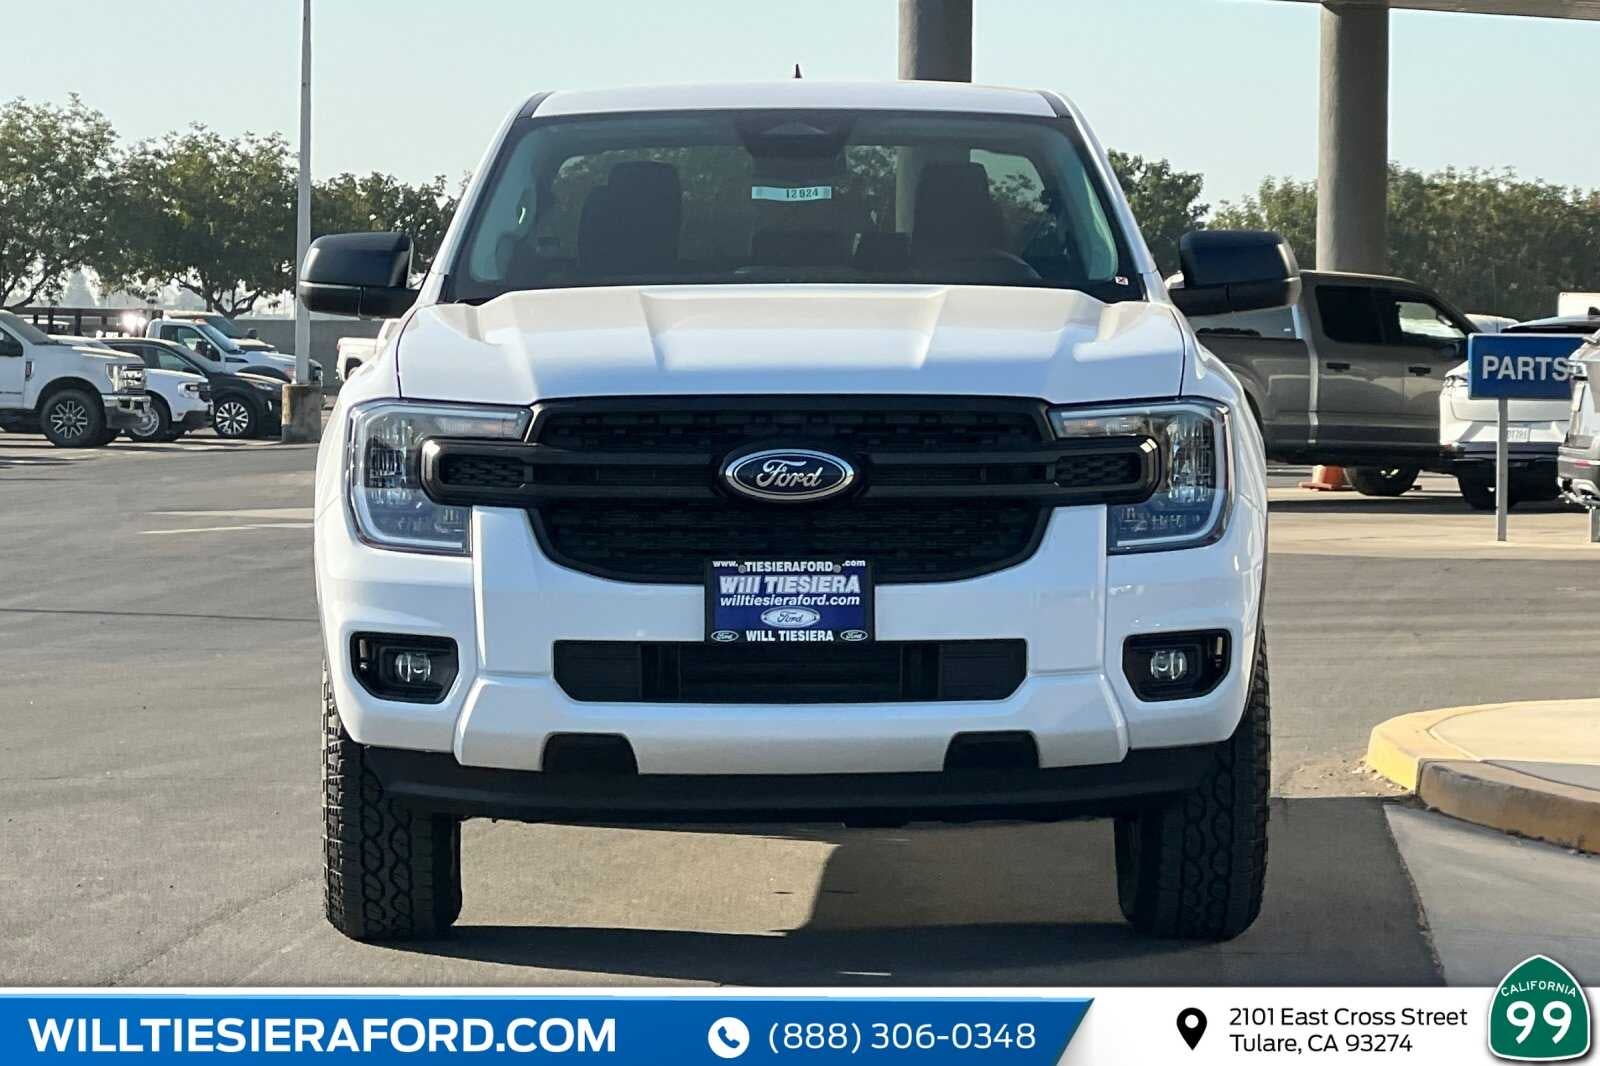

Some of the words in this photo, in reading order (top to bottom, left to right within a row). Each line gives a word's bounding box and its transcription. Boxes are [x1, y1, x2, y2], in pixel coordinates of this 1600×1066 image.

[1482, 355, 1569, 381] PARTS
[756, 459, 824, 488] Ford
[712, 560, 739, 568] www.
[744, 561, 834, 573] TIESIERAFORD
[763, 575, 861, 594] TIESIERA
[720, 594, 860, 607] willtiesieraford.com
[777, 612, 804, 624] Ford
[746, 630, 776, 642] WILL
[778, 630, 835, 642] TIESIERA
